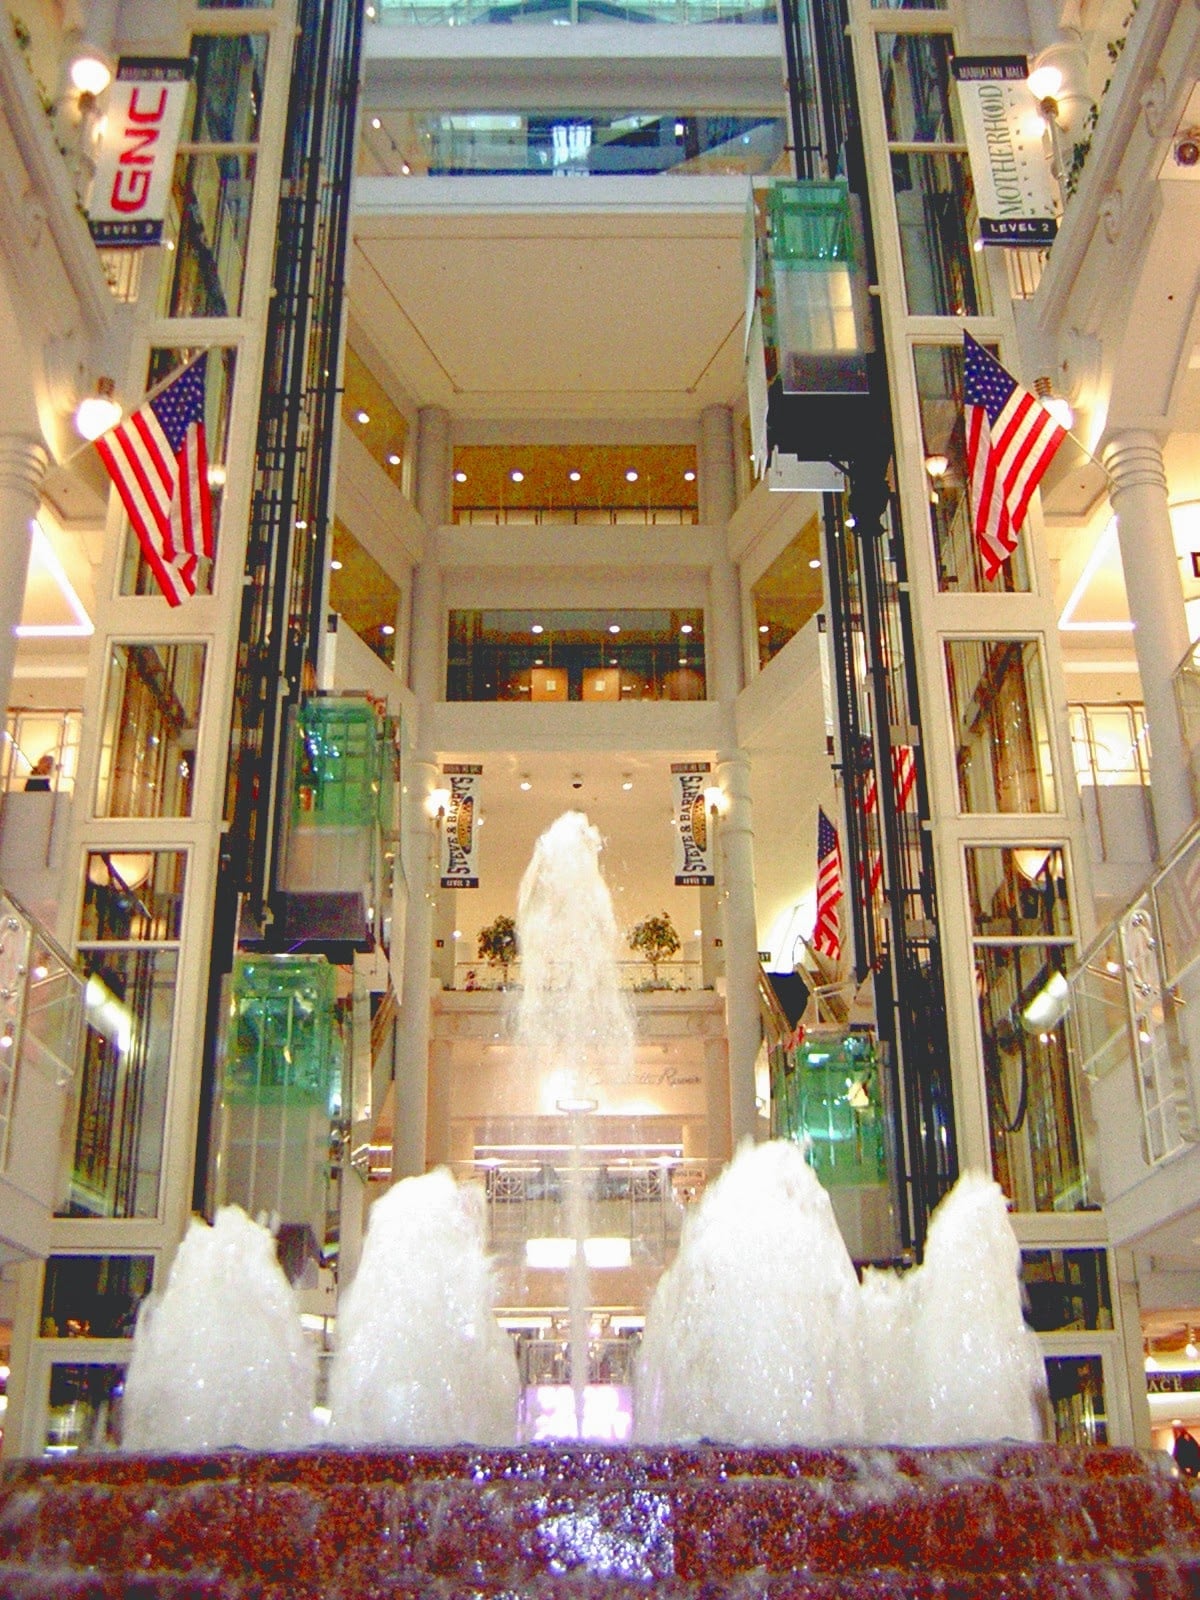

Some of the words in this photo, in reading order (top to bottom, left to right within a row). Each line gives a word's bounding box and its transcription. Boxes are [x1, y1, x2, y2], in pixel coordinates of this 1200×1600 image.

[1005, 66, 1025, 78] MALL
[110, 87, 168, 213] GNC
[978, 84, 1022, 215] MOTHERHOOD
[145, 223, 153, 235] 2
[990, 222, 1037, 234] LEVEL
[1042, 223, 1050, 233] 2
[446, 826, 457, 835] &
[680, 824, 692, 833] &
[447, 836, 471, 875] STEVE
[682, 835, 707, 872] STEVE
[1147, 1376, 1183, 1391] ACE
